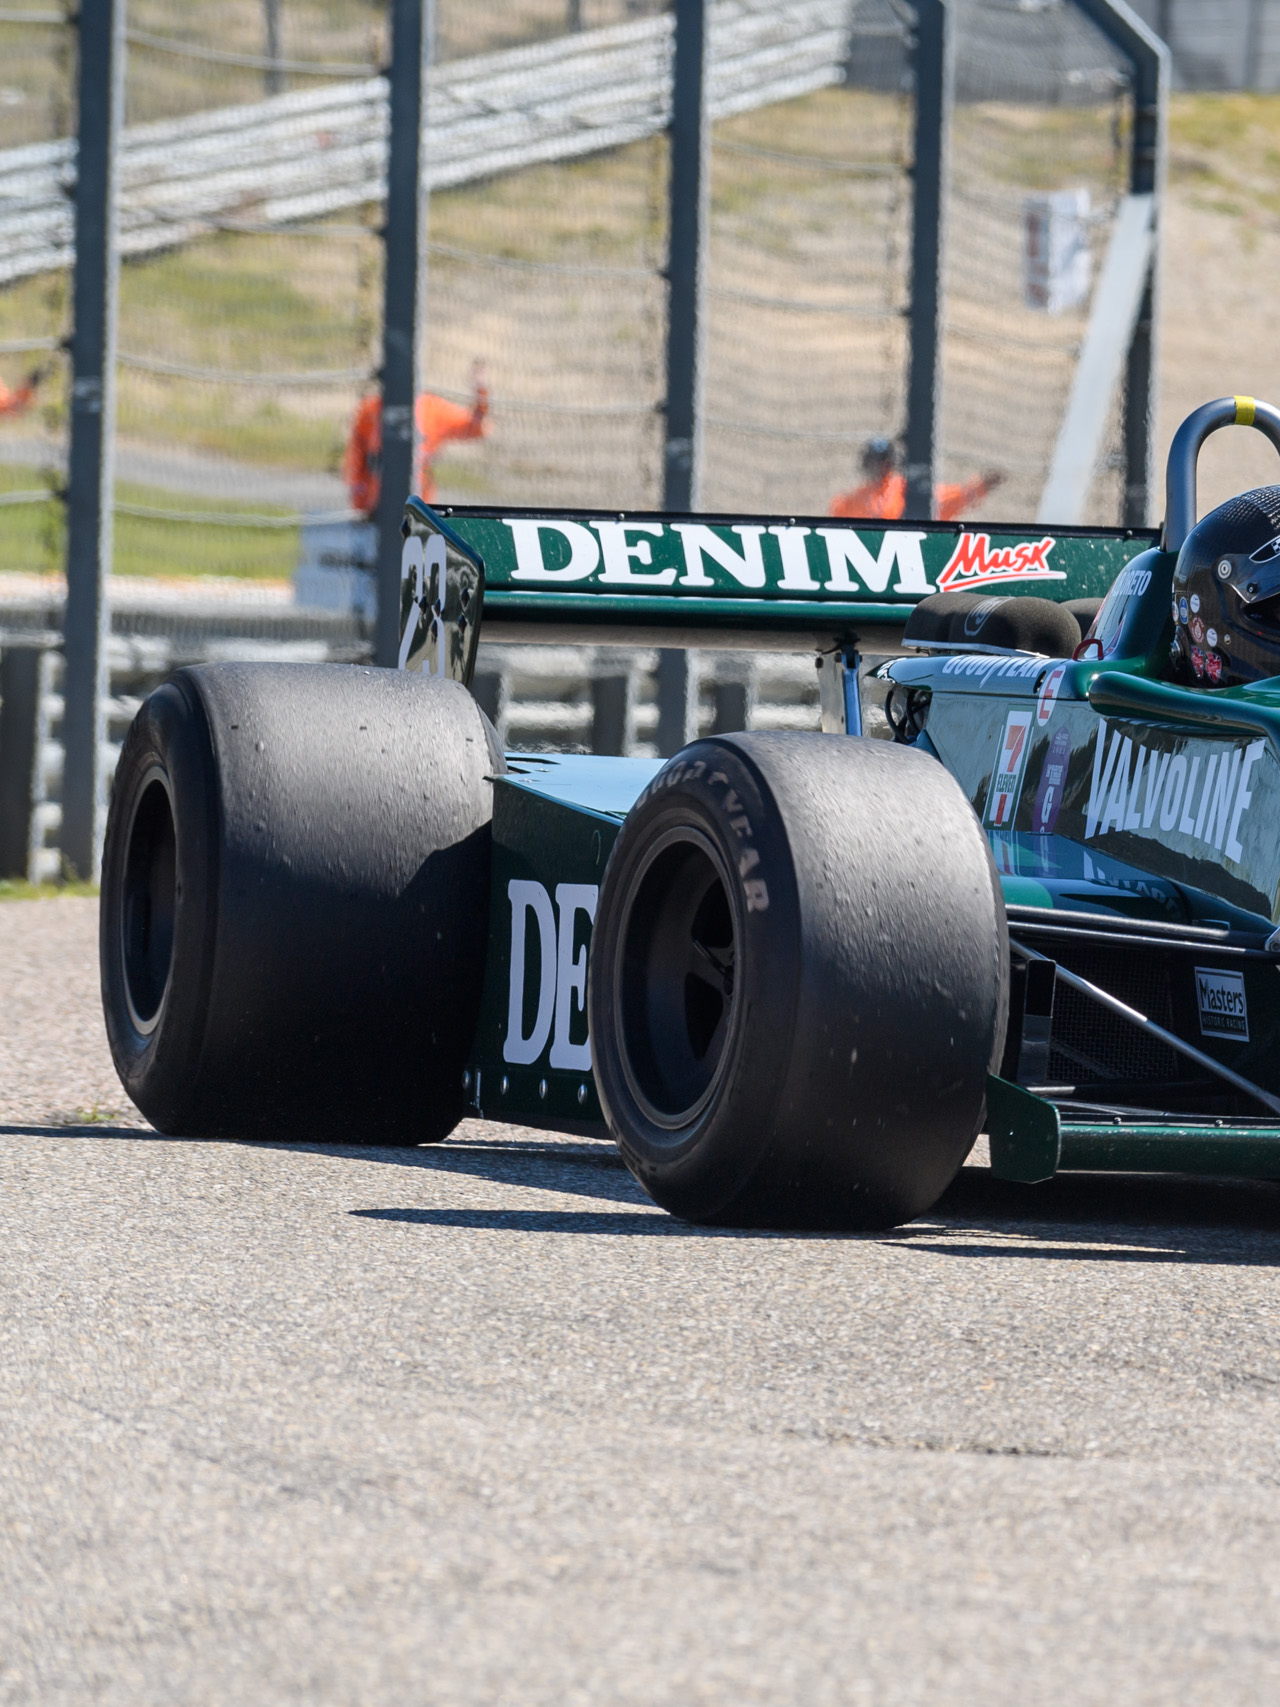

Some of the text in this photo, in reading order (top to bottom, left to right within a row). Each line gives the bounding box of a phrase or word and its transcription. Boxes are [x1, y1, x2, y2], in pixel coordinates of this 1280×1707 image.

[503, 518, 937, 595] DENIM
[398, 533, 447, 680] 23
[1038, 670, 1064, 719] E
[1084, 717, 1266, 864] VALVOLINE
[1199, 977, 1244, 1014] Masters
